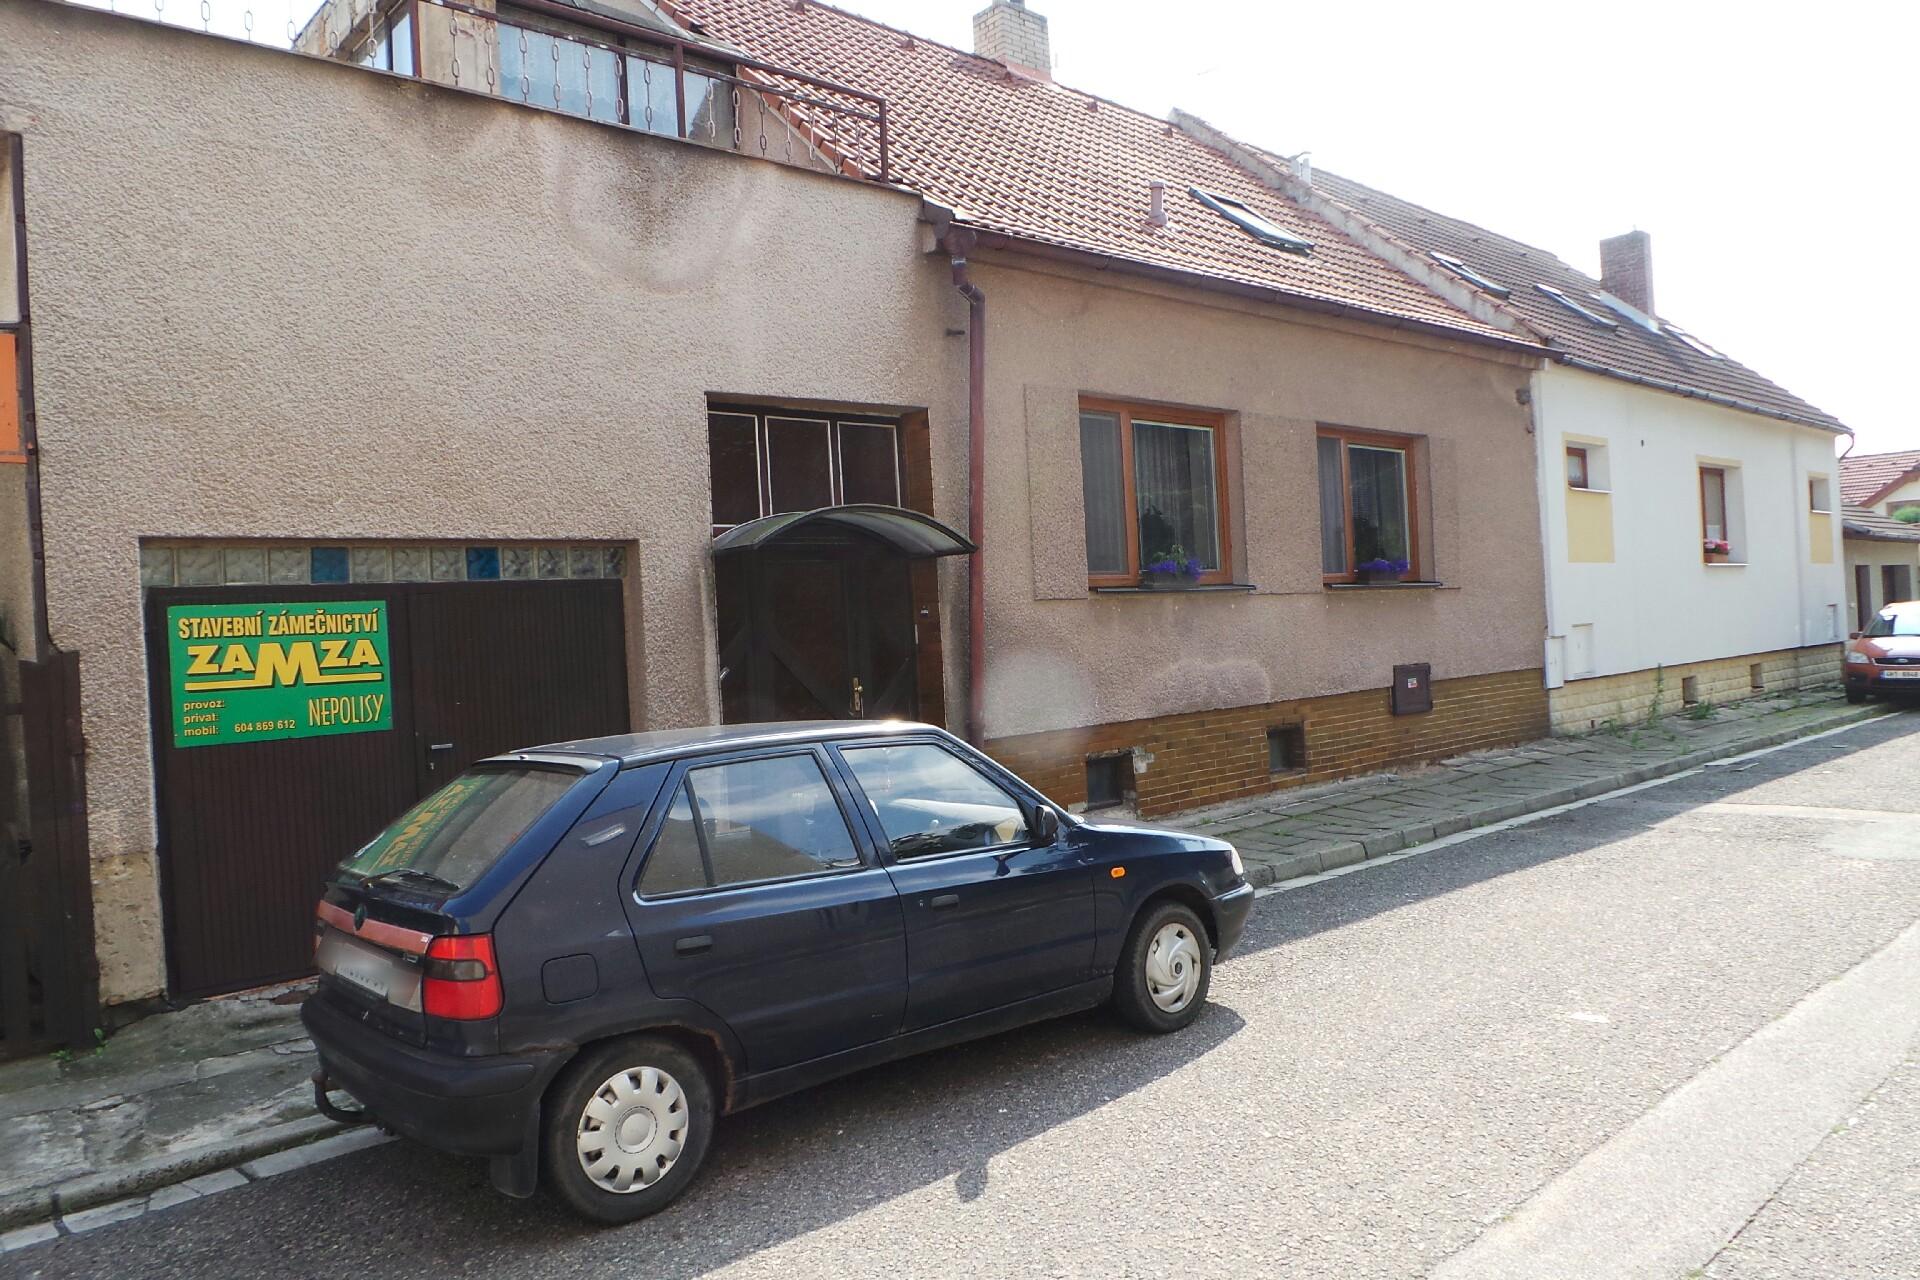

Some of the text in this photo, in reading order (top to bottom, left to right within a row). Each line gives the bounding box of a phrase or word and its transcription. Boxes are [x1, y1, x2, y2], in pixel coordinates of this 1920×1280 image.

[178, 608, 379, 639] STAVEBNÍ ZÁMEČNICTVÍ
[185, 639, 382, 688] ZAMZA
[183, 700, 225, 713] provoz:
[308, 694, 384, 727] NEPOLISY
[184, 725, 219, 737] mobil:
[234, 722, 253, 733] 604
[277, 719, 296, 730] 612
